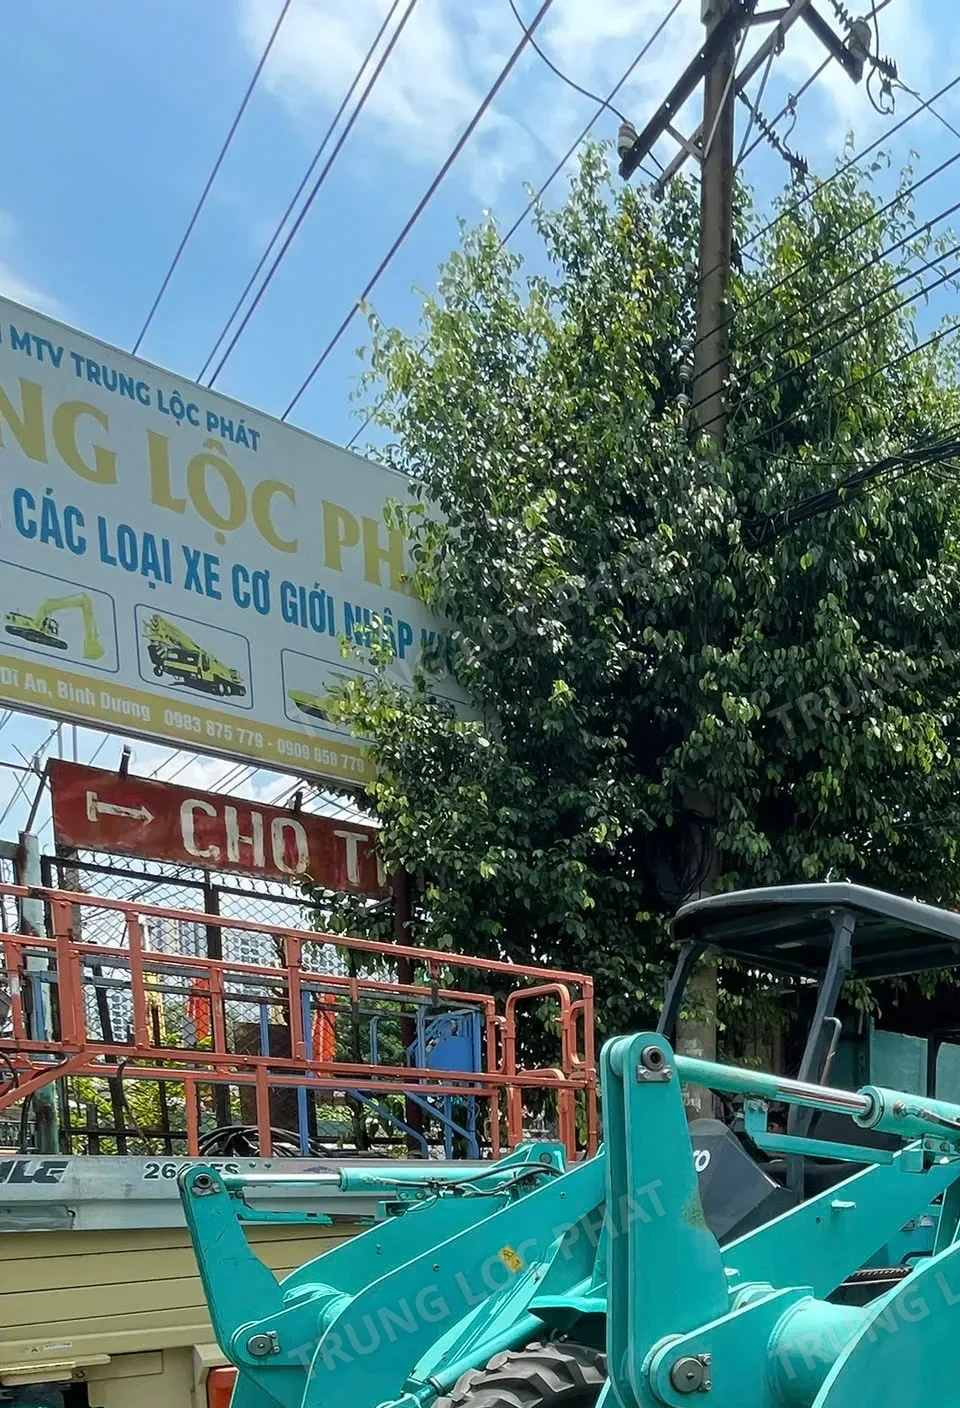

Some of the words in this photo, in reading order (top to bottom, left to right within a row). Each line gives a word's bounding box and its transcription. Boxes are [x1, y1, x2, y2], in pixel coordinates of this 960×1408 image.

[10, 324, 64, 369] MTV
[70, 351, 151, 406] TRUNG
[157, 389, 201, 427] LỘC
[206, 410, 261, 452] PHÁT
[146, 428, 298, 554] LỘC
[13, 487, 86, 556] CÁC
[98, 515, 172, 590] LOẠI
[182, 544, 222, 600] XE
[232, 562, 271, 616] CƠ
[280, 580, 336, 636] GIỚI
[164, 709, 201, 733] 0983
[206, 719, 233, 741] 875
[237, 727, 264, 749] 779
[0, 1160, 71, 1184] LG
